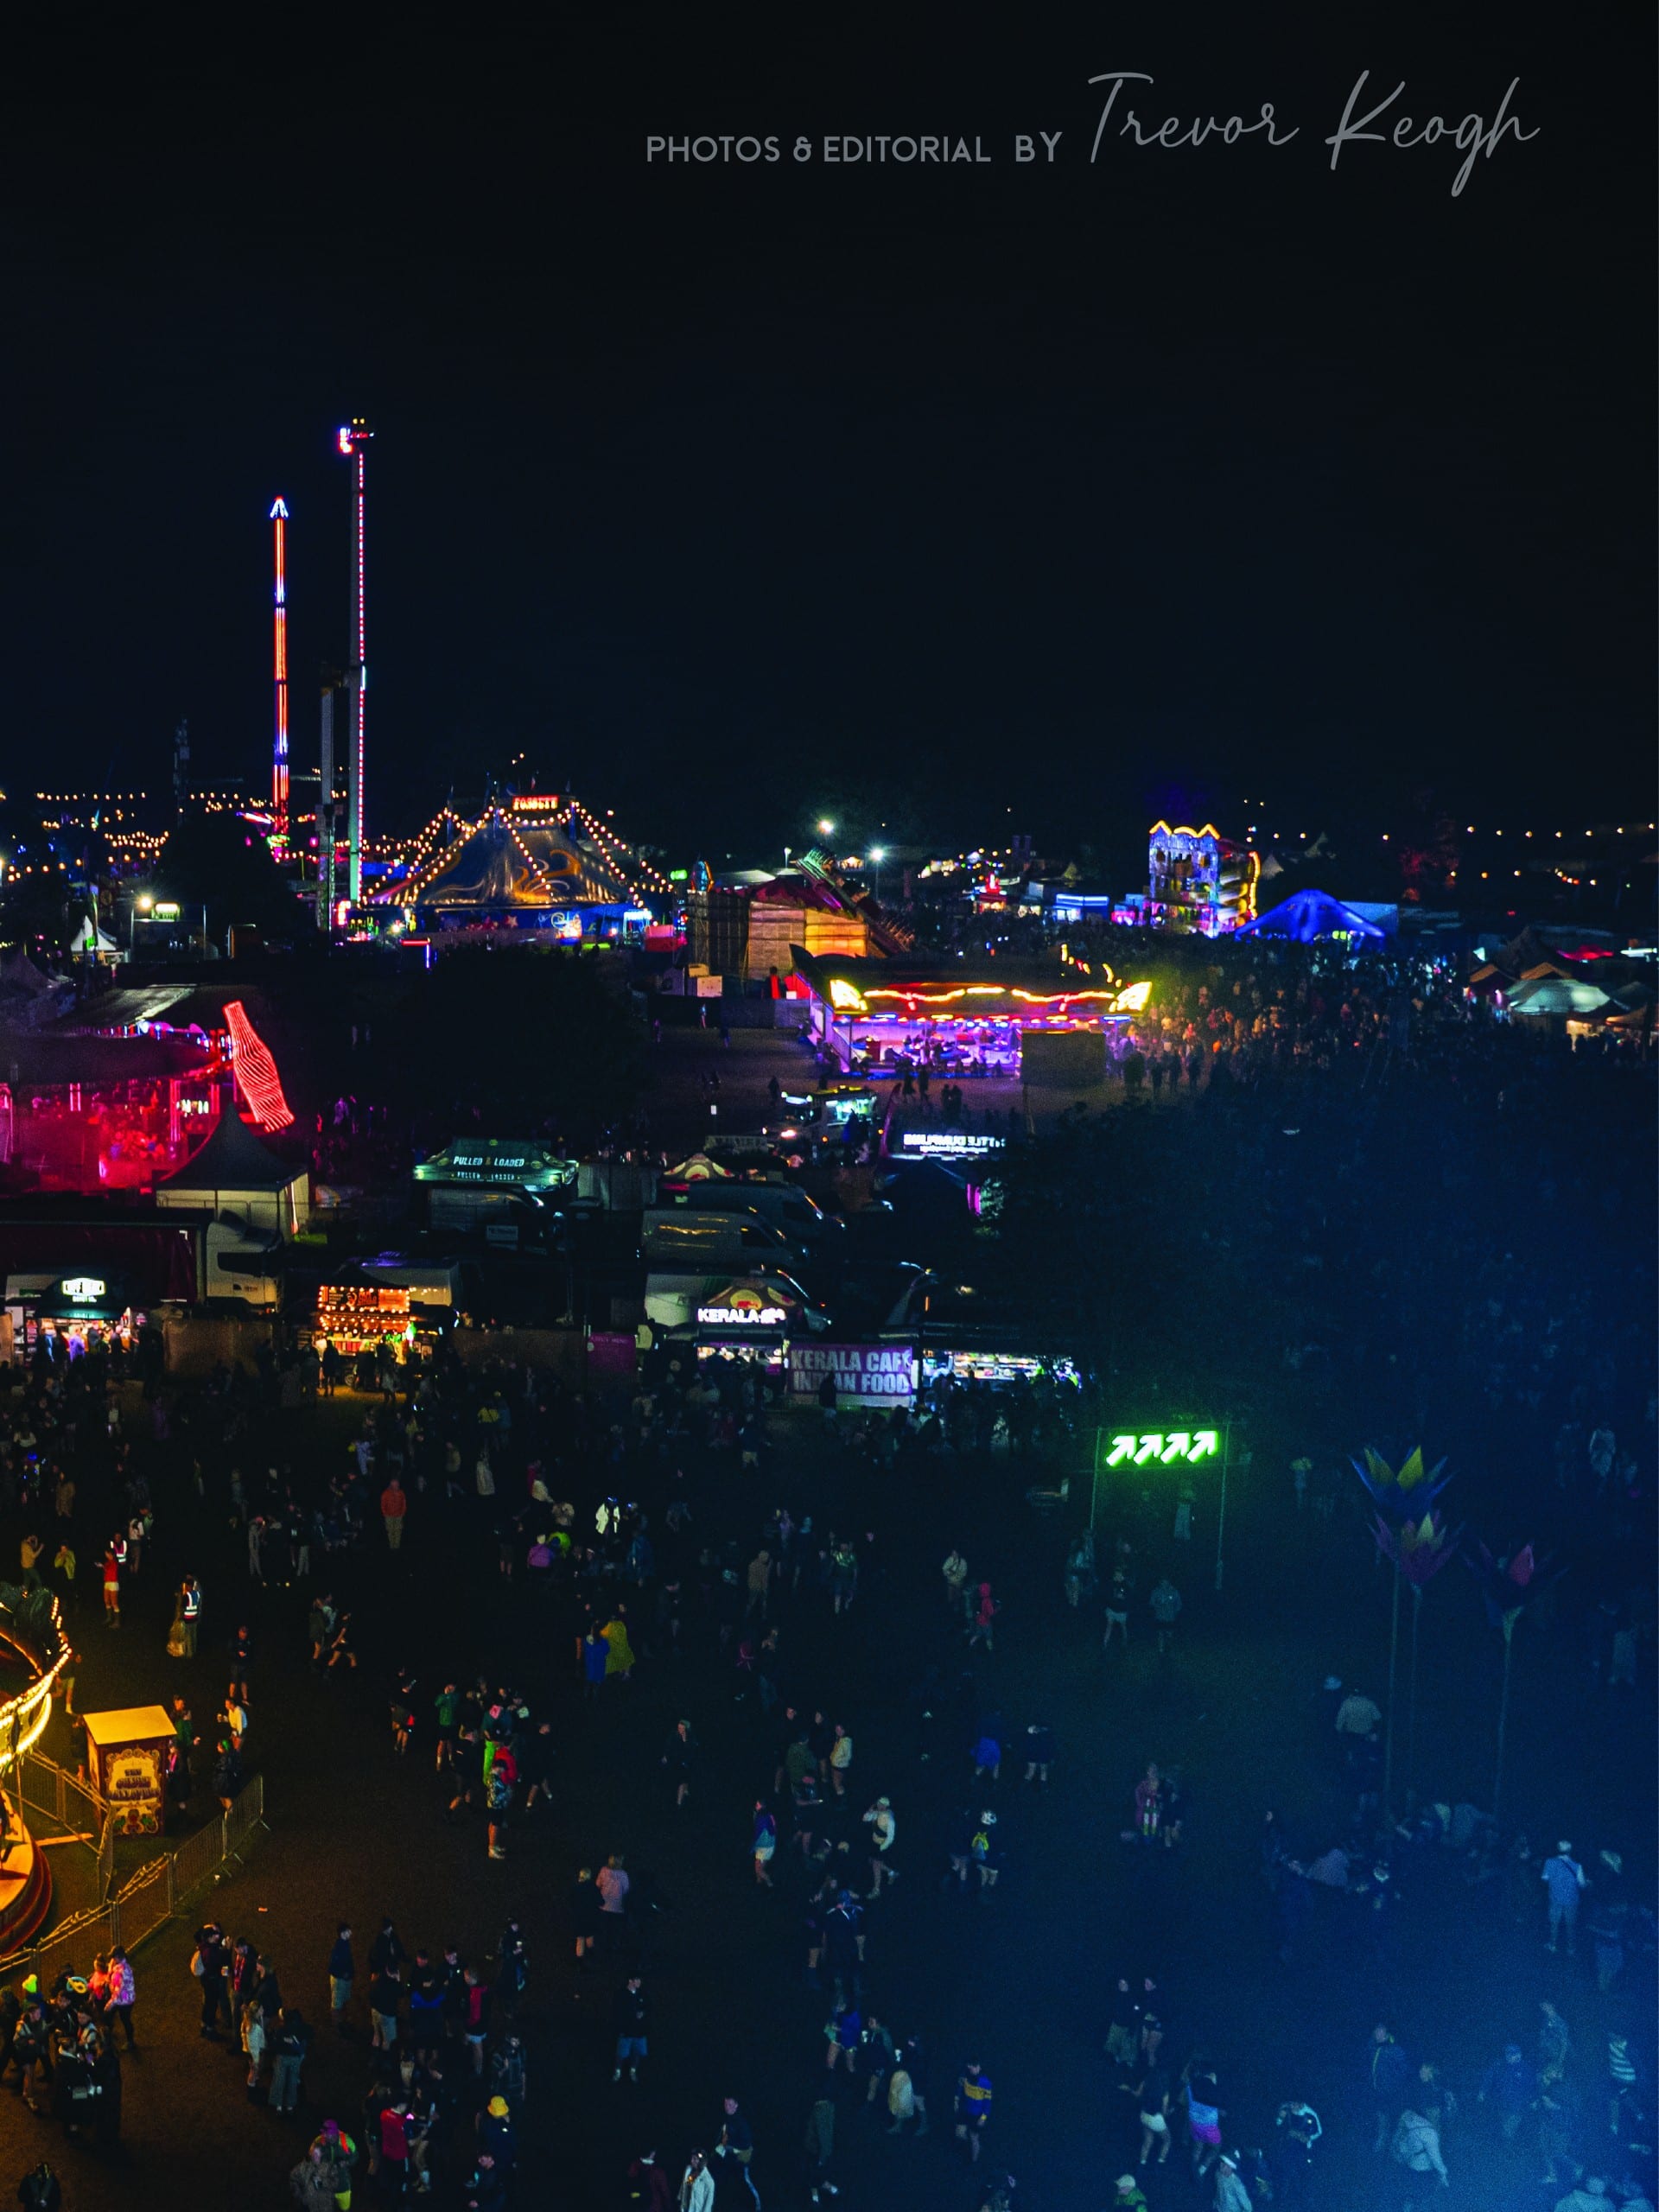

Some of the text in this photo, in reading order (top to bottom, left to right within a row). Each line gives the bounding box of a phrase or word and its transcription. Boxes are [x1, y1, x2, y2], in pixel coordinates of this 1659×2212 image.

[453, 1155, 483, 1166] PULLED
[493, 1157, 524, 1167] LOADED
[697, 1307, 760, 1323] KERALA
[791, 1349, 861, 1371] KERALA
[793, 1370, 910, 1394] INDAN FOOD
